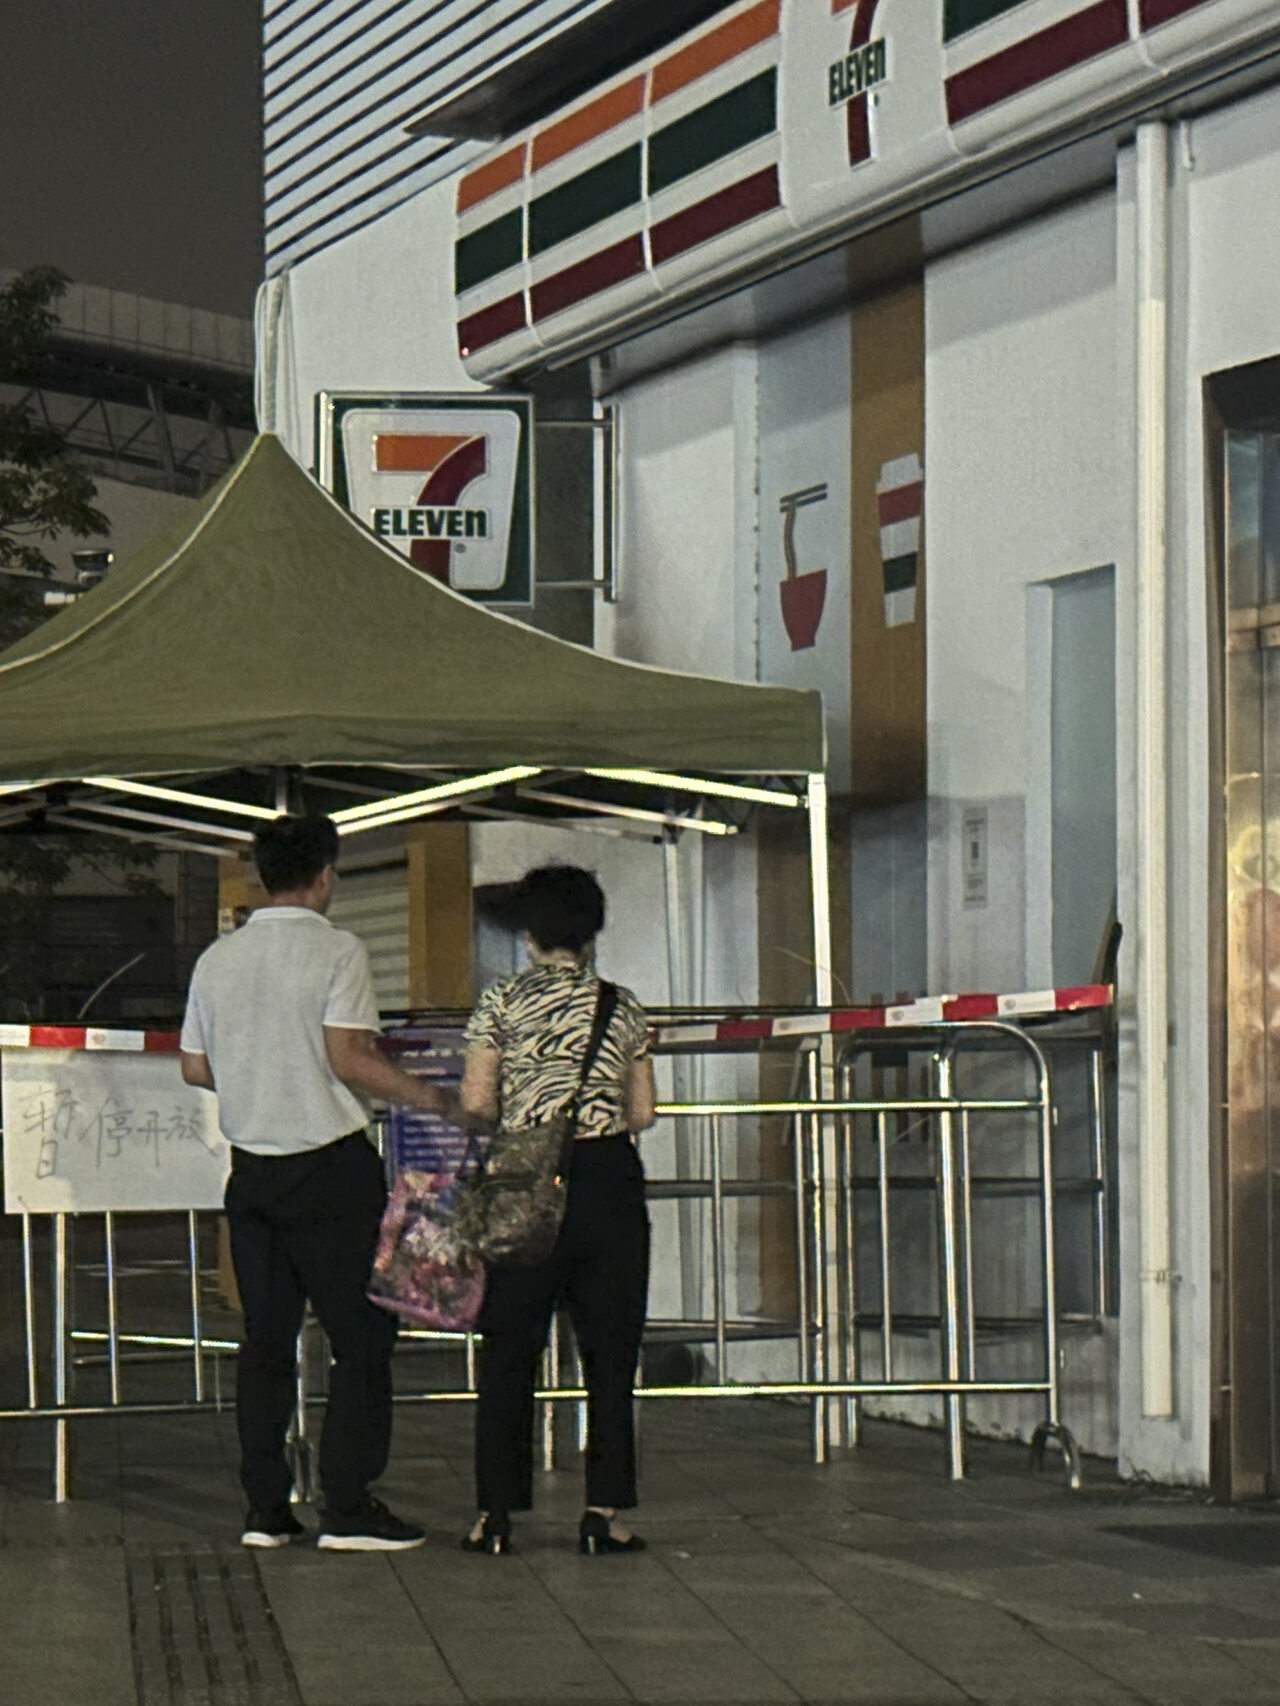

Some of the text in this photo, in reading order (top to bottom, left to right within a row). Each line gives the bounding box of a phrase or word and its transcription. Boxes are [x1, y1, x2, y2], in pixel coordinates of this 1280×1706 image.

[375, 434, 486, 584] 7
[20, 1087, 219, 1179] 暂停开放
